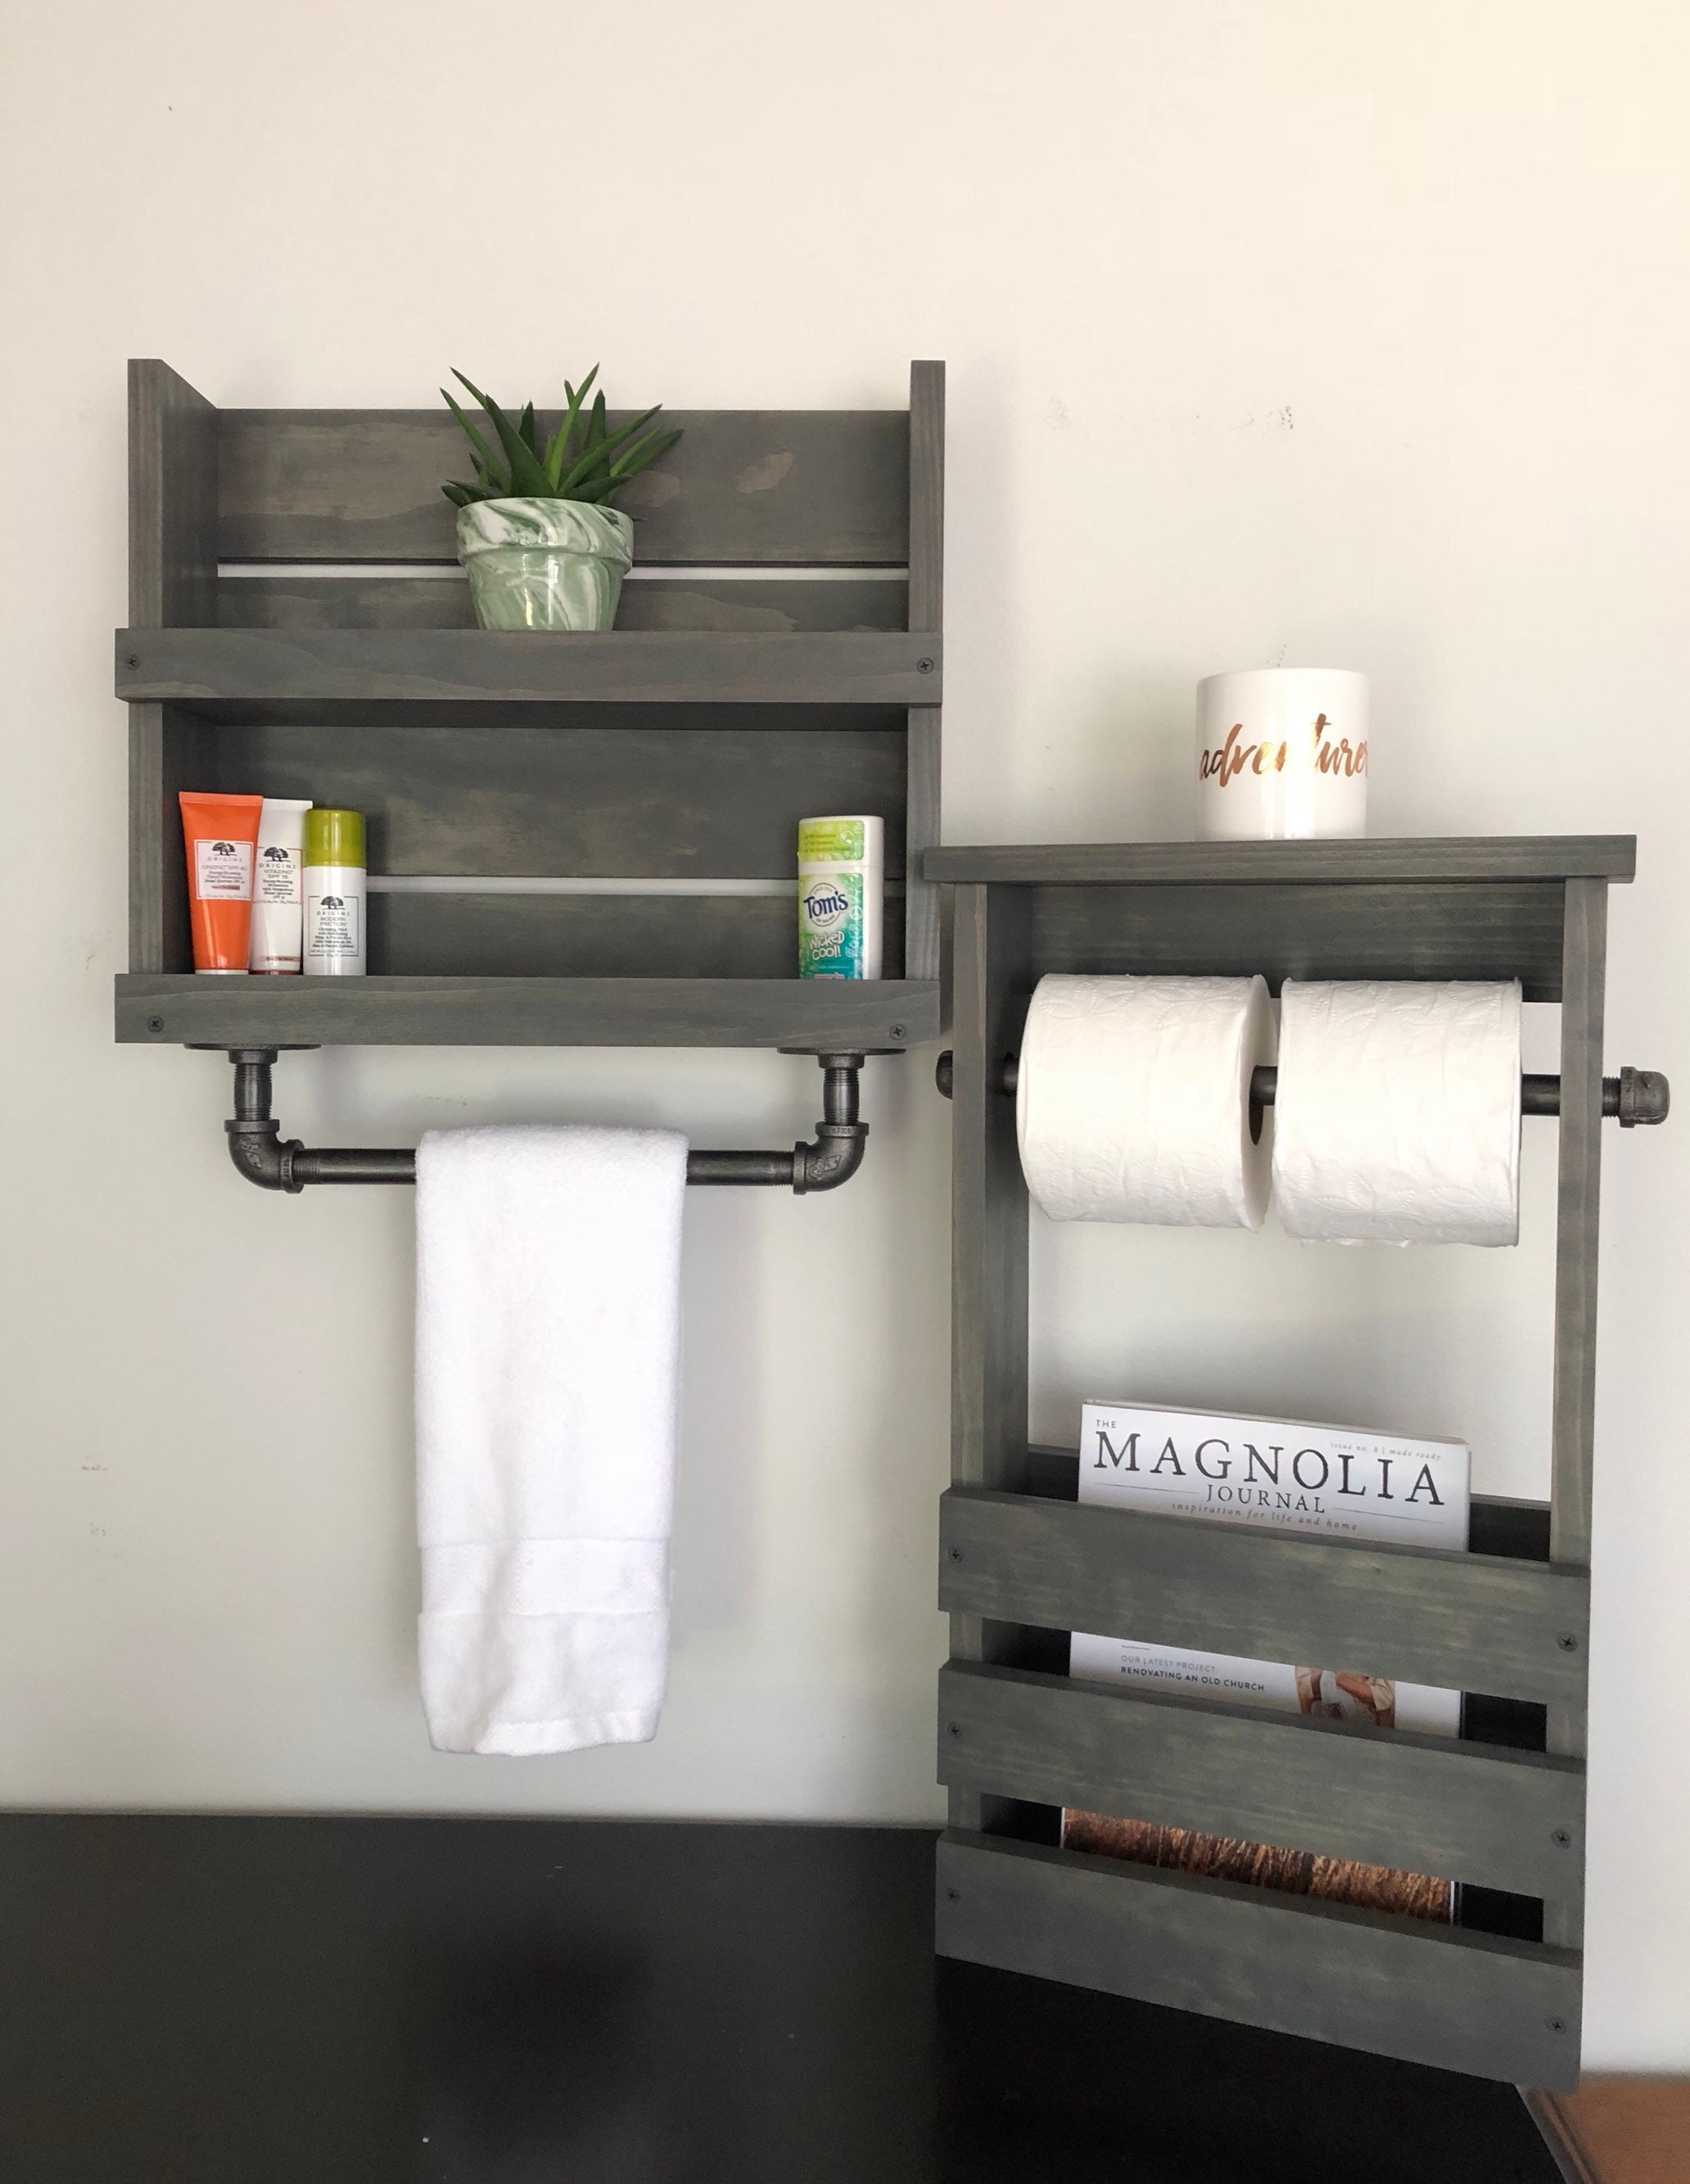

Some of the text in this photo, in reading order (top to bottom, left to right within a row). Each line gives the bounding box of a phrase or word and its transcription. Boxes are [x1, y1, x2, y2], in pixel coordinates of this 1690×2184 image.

[803, 890, 849, 919] Tom's
[1096, 1419, 1117, 1428] THE
[1331, 1442, 1352, 1451] issue
[1390, 1448, 1412, 1456] made
[1416, 1451, 1441, 1461] ready
[1093, 1430, 1444, 1505] MAGNOLIA
[1206, 1484, 1325, 1514] JOURNAL
[1172, 1501, 1358, 1532] inspiration for life and home
[1121, 1655, 1141, 1664] OUR
[1143, 1657, 1173, 1667] LATEST
[1121, 1666, 1265, 1691] RENOVATING AN OLD CHURCH
